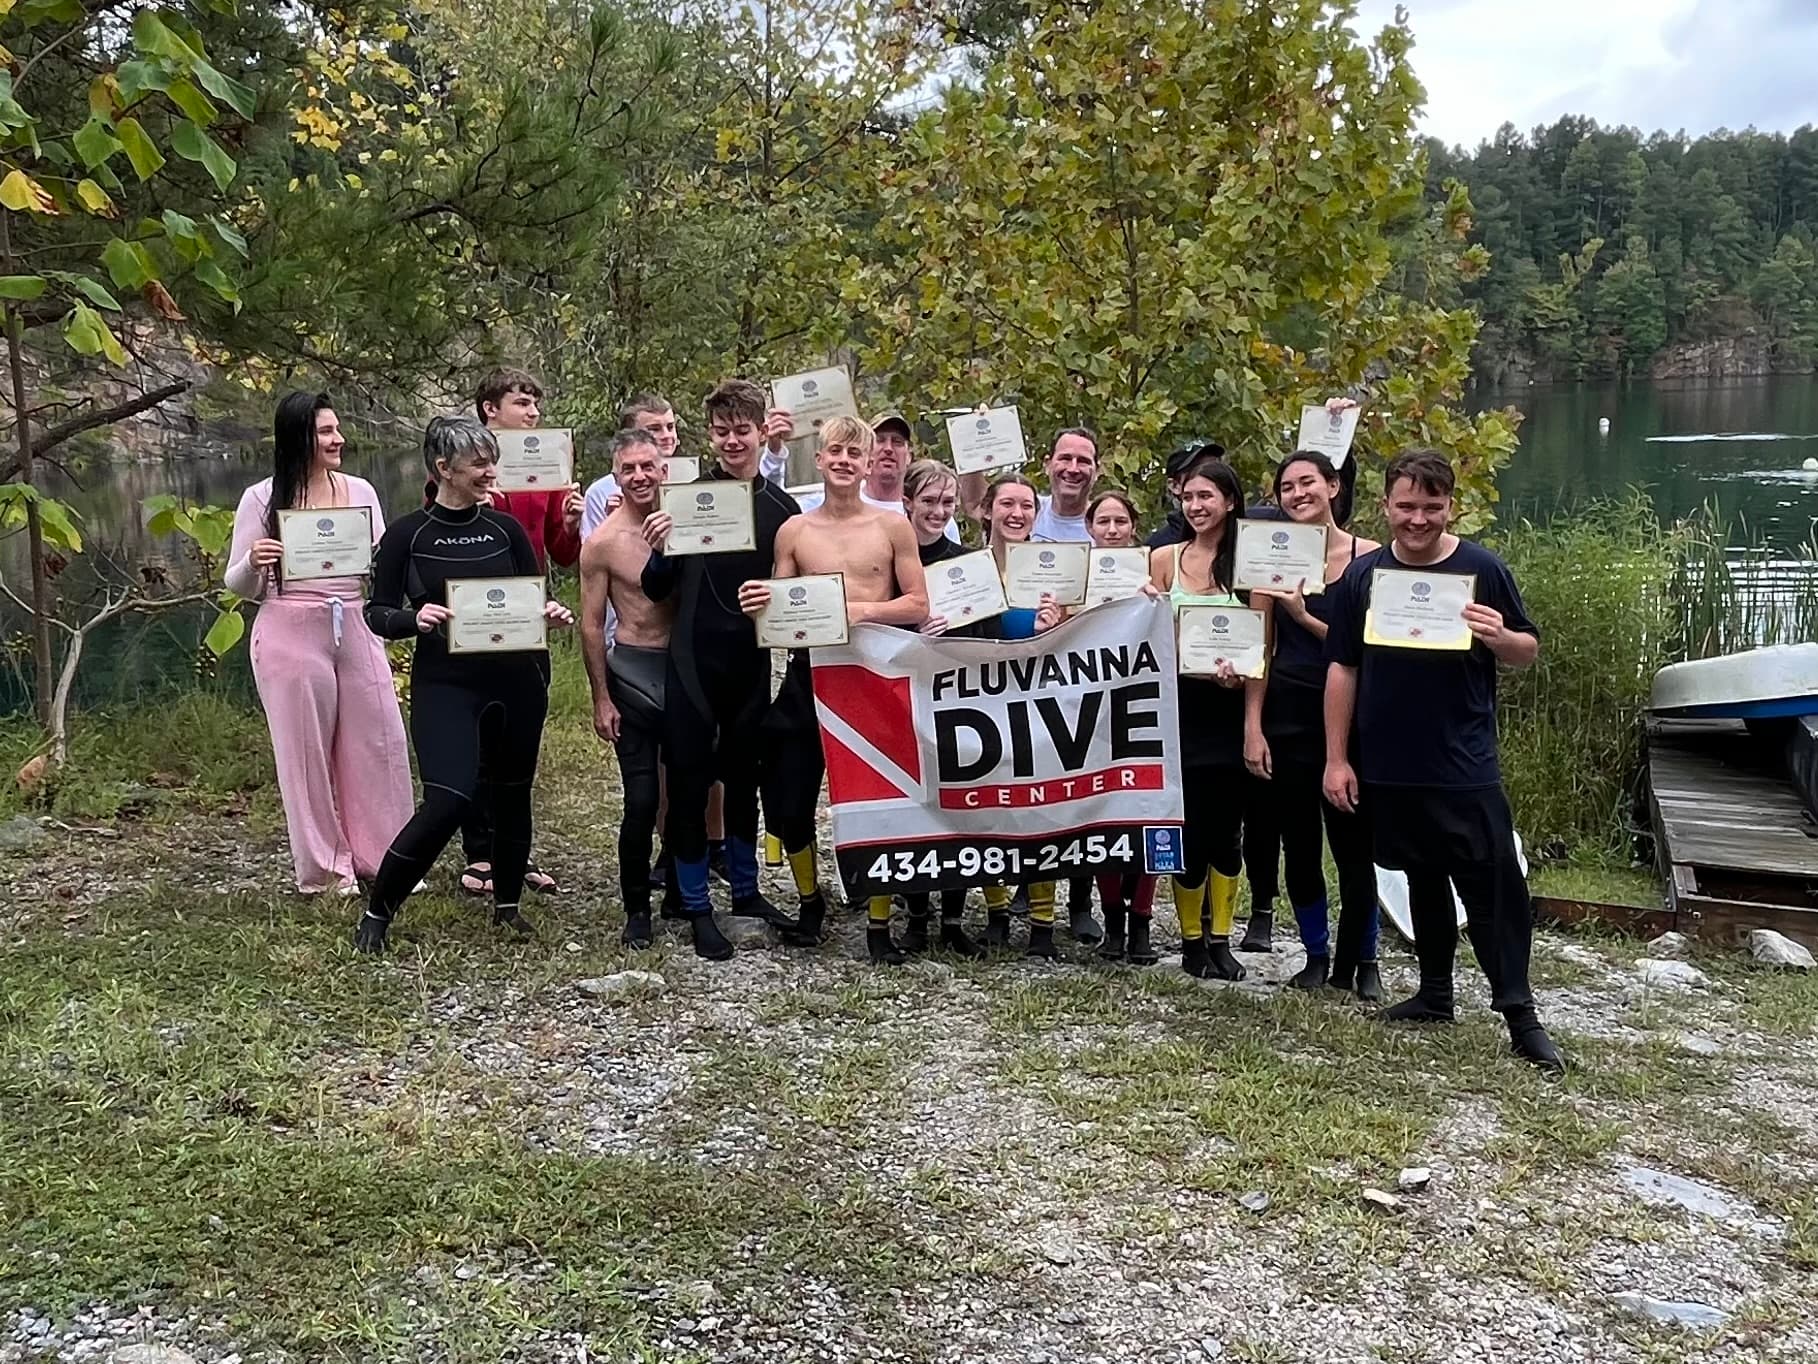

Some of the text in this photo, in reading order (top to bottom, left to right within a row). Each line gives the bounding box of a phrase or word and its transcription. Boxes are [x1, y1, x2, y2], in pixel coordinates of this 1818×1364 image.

[932, 641, 1160, 701] FLUVANNA
[933, 681, 1164, 783] DIVE
[964, 768, 1136, 806] CENTER
[867, 834, 1134, 883] 434-981-2454
